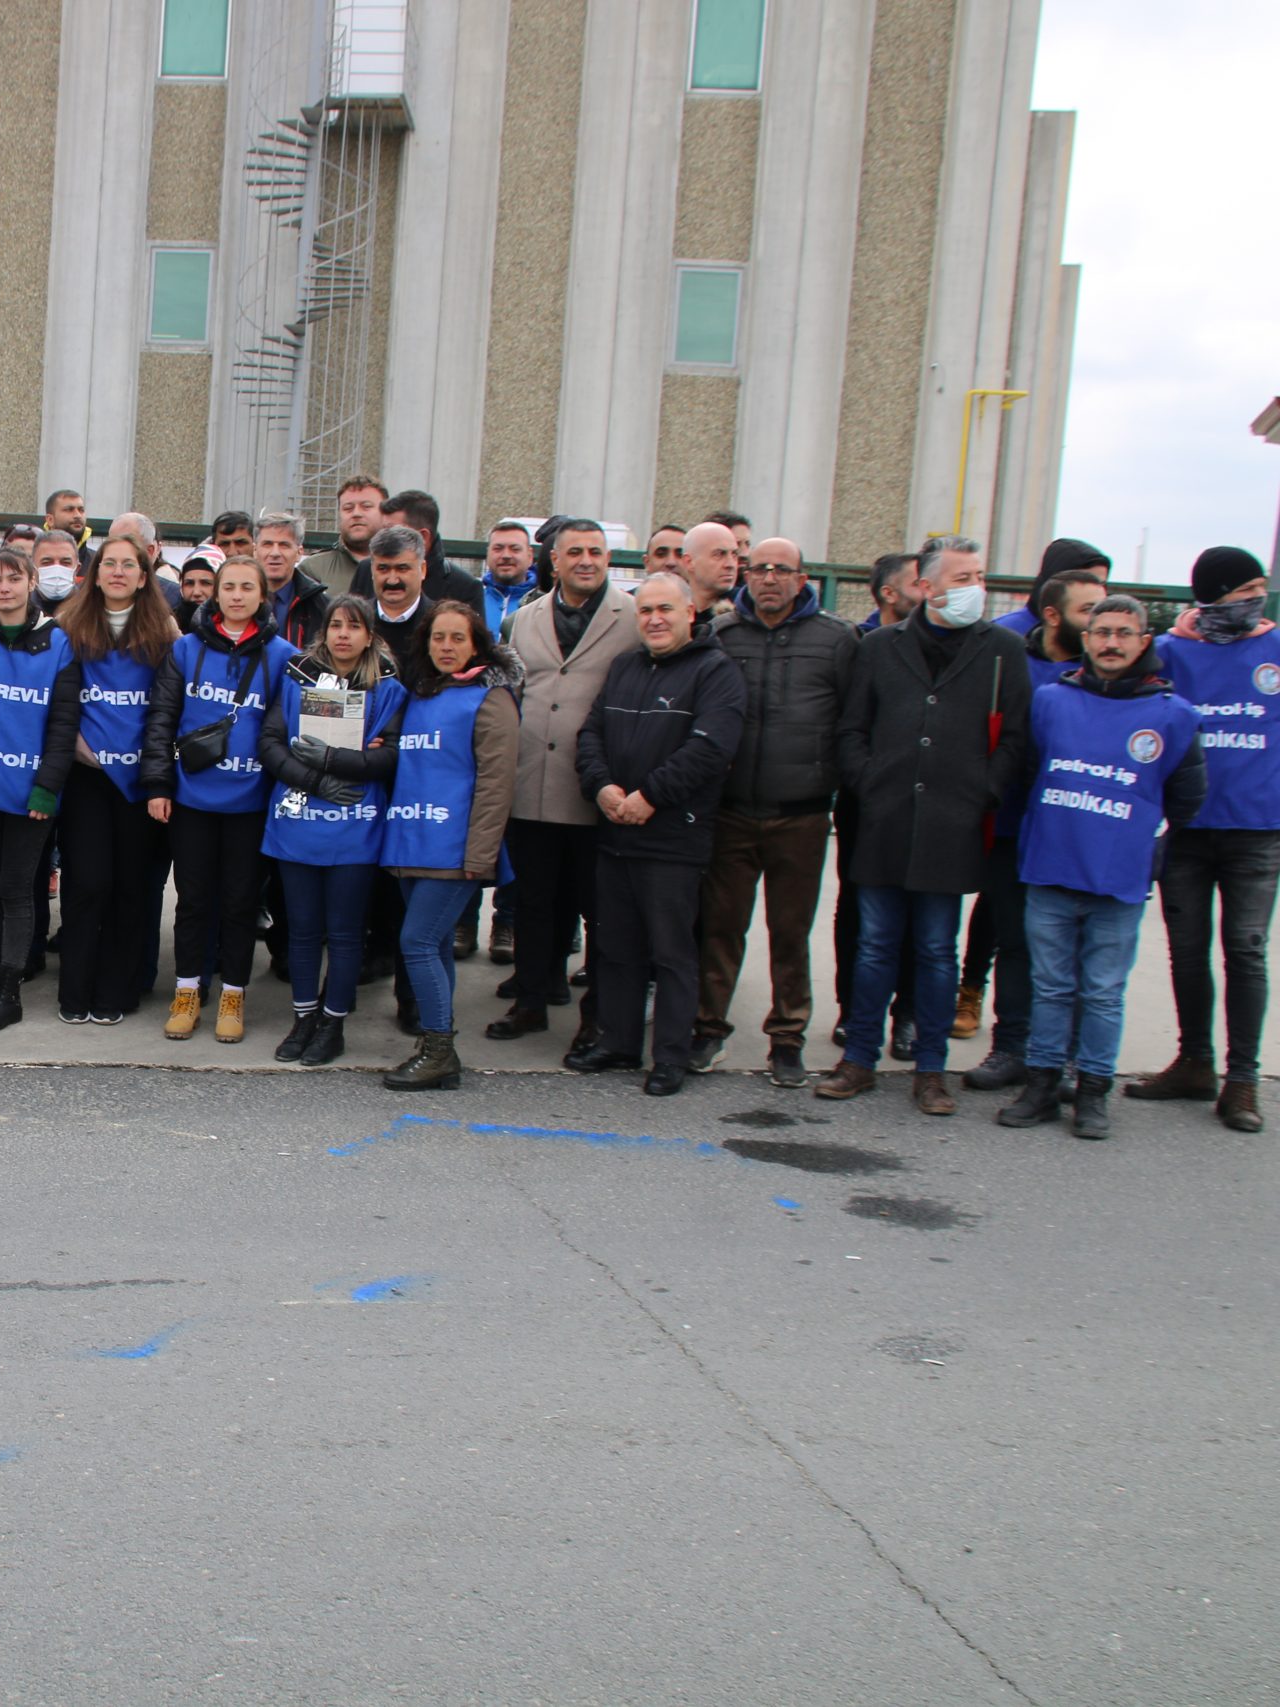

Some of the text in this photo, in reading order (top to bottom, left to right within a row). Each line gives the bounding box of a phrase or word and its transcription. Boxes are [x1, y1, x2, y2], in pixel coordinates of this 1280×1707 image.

[79, 683, 151, 706] GÖREVL
[1047, 758, 1138, 786] petrol-iş
[1040, 787, 1132, 820] SENDİKASI
